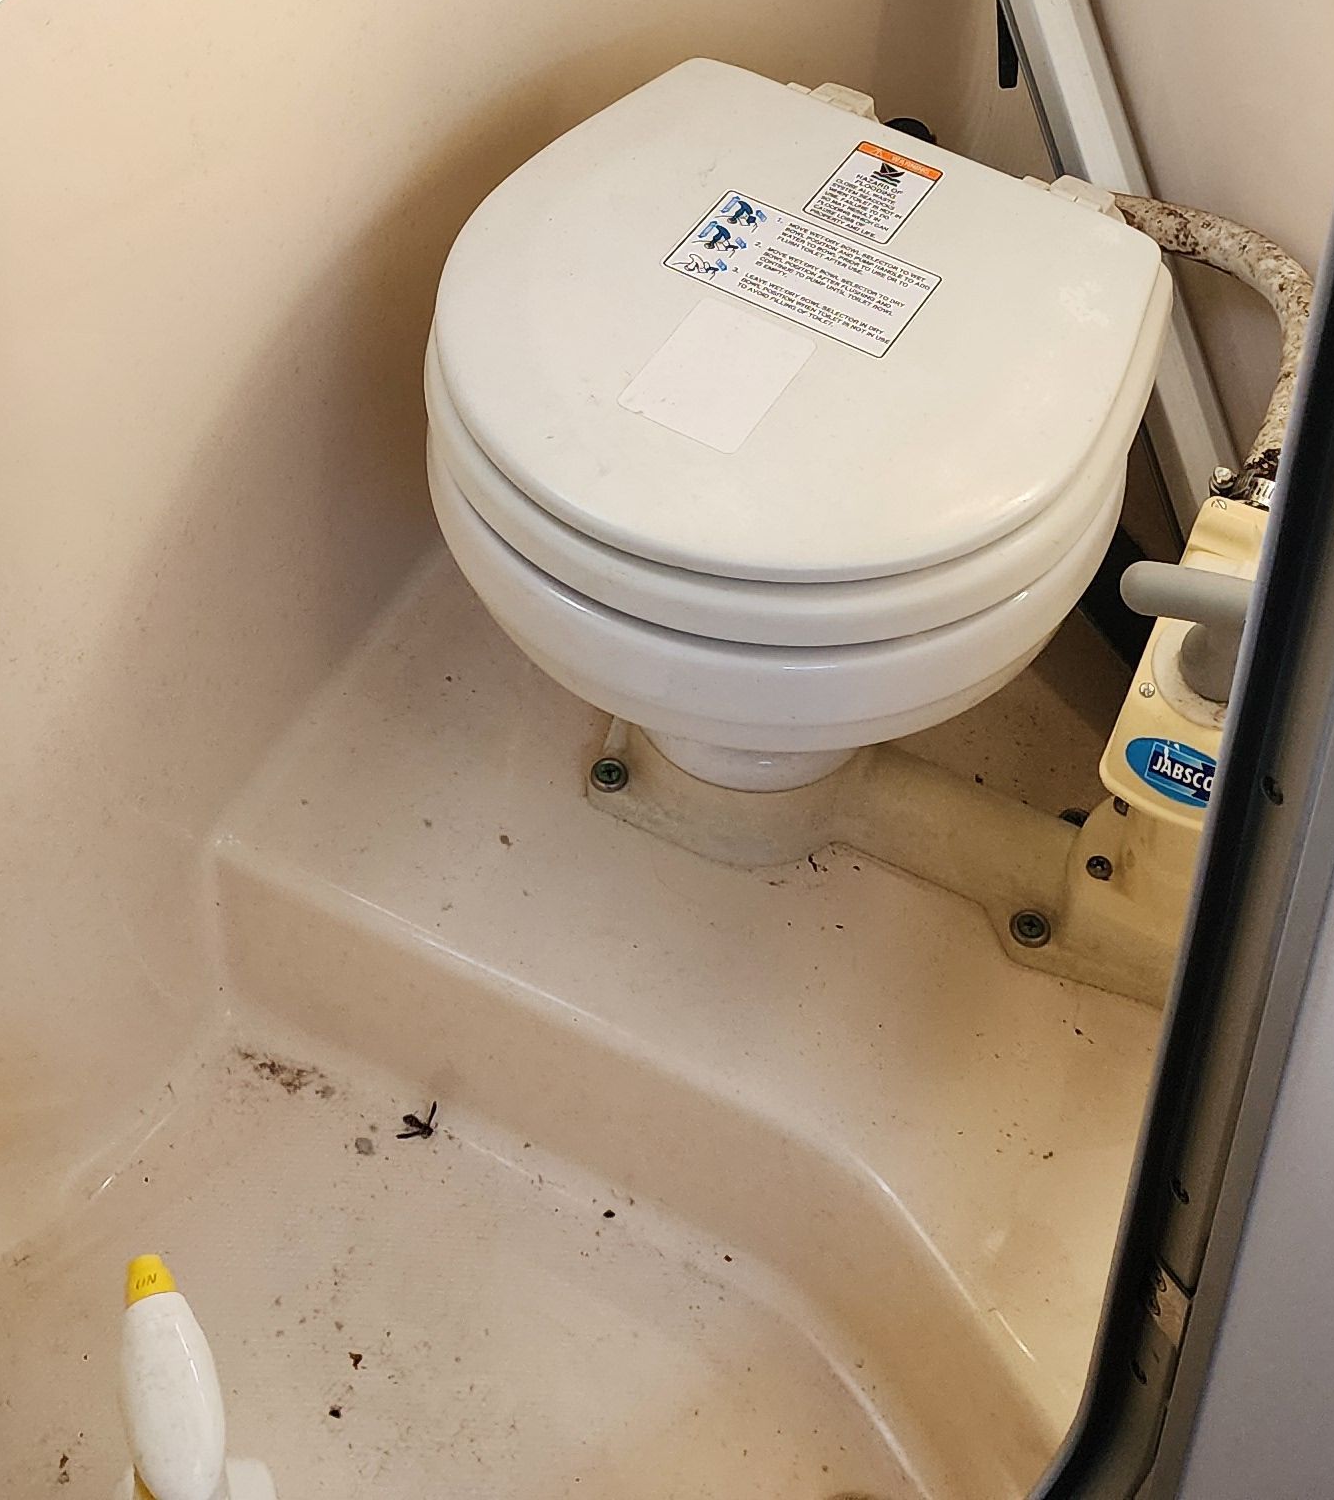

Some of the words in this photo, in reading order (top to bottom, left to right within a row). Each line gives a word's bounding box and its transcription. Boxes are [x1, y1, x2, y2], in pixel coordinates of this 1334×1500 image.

[853, 179, 897, 199] FLOODING
[855, 173, 890, 190] HAZARD
[889, 187, 903, 195] OF
[762, 251, 785, 263] BOWL
[783, 260, 817, 277] POSITION
[816, 274, 841, 287] AFTER
[839, 284, 876, 301] FLUSHING
[875, 299, 892, 308] AND
[766, 247, 787, 258] MOVE
[818, 268, 841, 280] BOWL
[840, 277, 878, 296] SELECTOR
[877, 293, 889, 301] TO
[888, 298, 905, 307] DRY
[776, 235, 800, 248] FLUSH
[799, 245, 825, 258] TOILET
[823, 255, 848, 268] AFTER
[779, 231, 806, 244] WATER
[804, 241, 816, 249] TO
[815, 246, 838, 257] BOWL
[837, 255, 860, 267] PRIOR
[870, 268, 887, 278] USE
[886, 275, 899, 283] OR
[783, 227, 806, 238] BOWL
[805, 235, 838, 252] POSITION
[837, 249, 854, 258] AND
[853, 255, 874, 267] PUMP
[873, 264, 903, 278] HANDLE
[914, 280, 931, 290] ADD
[787, 222, 809, 233] MOVE
[839, 243, 862, 255] BOWL
[861, 252, 899, 270] SELECTOR
[898, 267, 910, 275] TO
[909, 272, 926, 282] WET
[735, 281, 748, 289] TO
[746, 286, 770, 299] AVOID
[768, 295, 797, 311] FILLING
[795, 307, 808, 315] OF
[740, 277, 762, 289] BOWL
[761, 286, 795, 303] POSITION
[794, 300, 818, 313] WHEN
[817, 310, 843, 323] TOILET
[849, 324, 867, 334] NOT
[873, 334, 890, 344] USE
[744, 272, 768, 285] LEAVE
[799, 296, 822, 308] BOWL
[821, 305, 859, 324] SELECTOR
[867, 325, 884, 335] DRY
[758, 256, 794, 273] CONTINUE
[804, 275, 826, 287] PUMP
[825, 284, 847, 296] UNTIL
[846, 293, 872, 306] TOILET
[871, 303, 894, 316] BOWL
[1152, 756, 1214, 793] JABSCO
